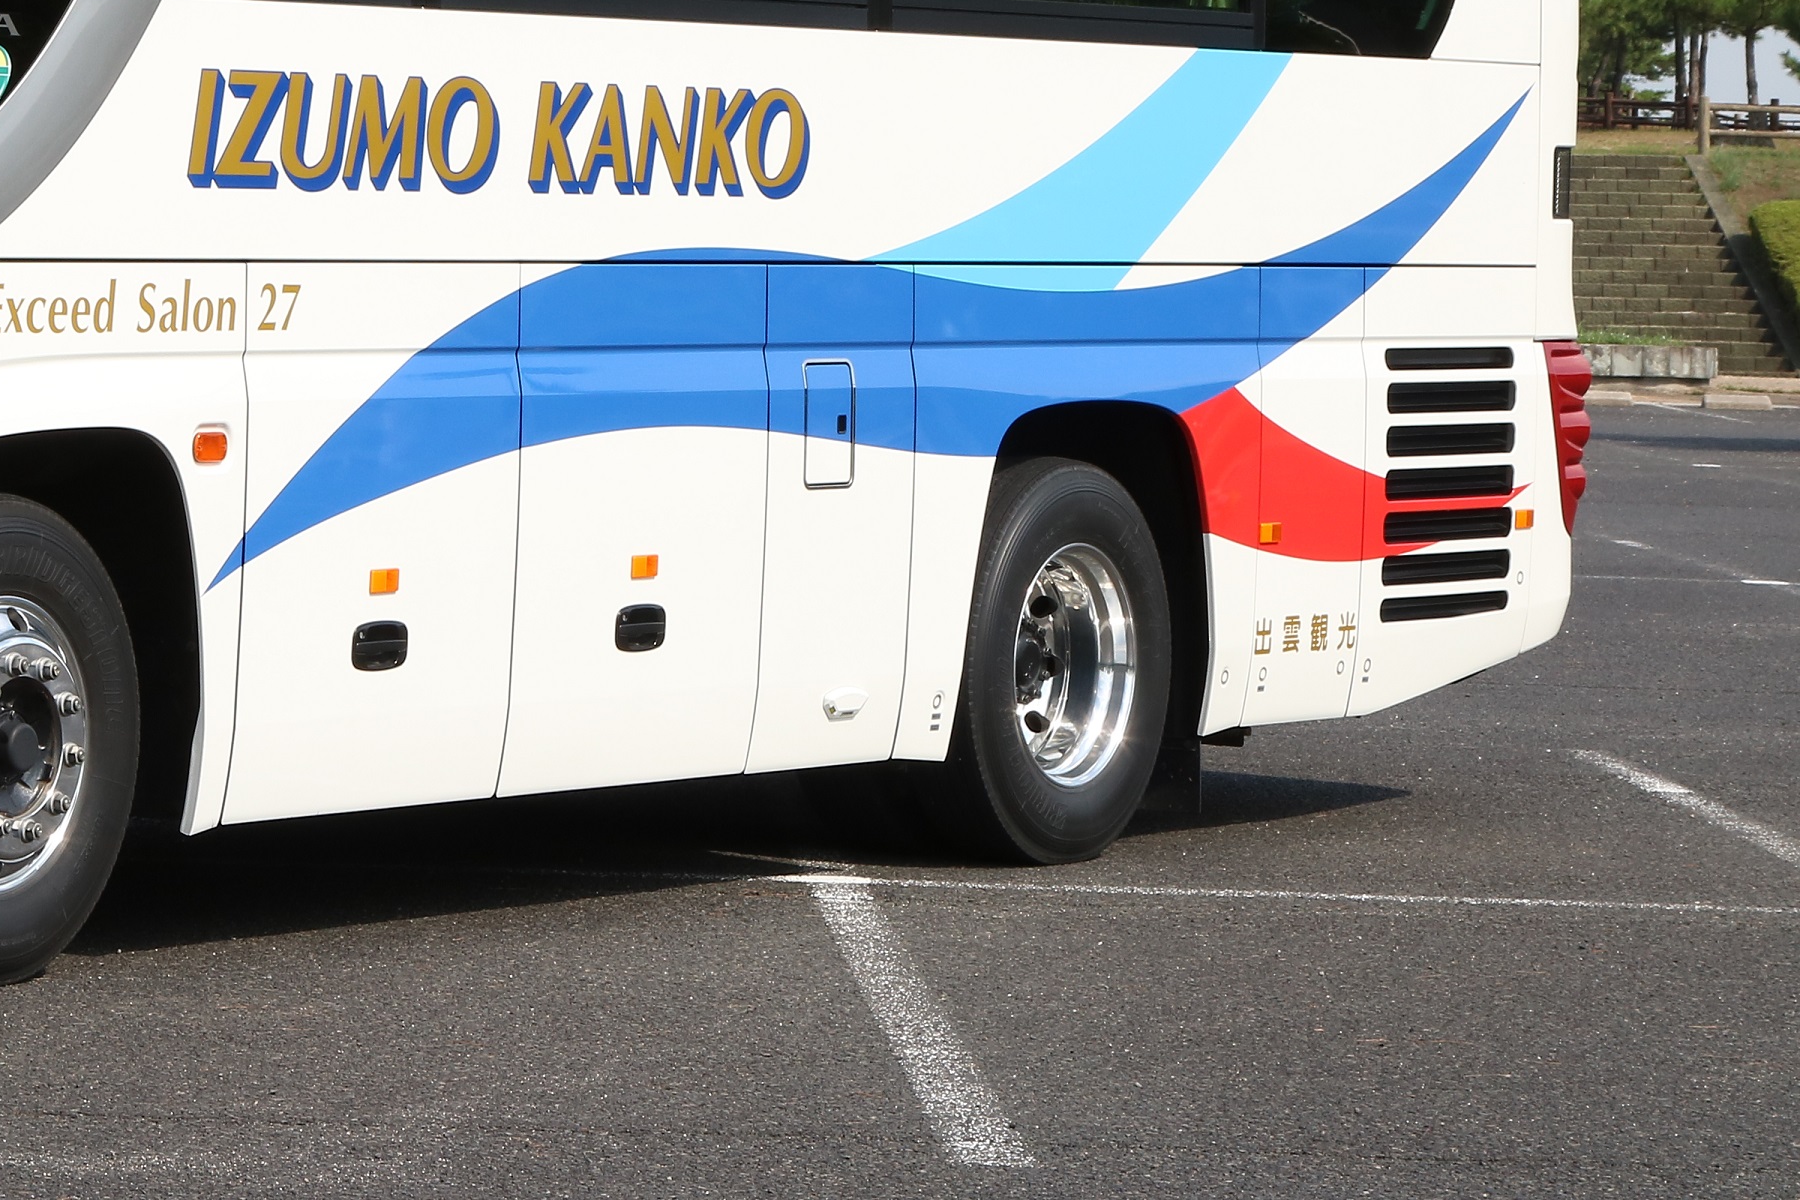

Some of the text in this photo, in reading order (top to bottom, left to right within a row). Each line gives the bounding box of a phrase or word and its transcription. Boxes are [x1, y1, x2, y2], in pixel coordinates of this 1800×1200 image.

[187, 68, 811, 200] IZUMO KANKO
[136, 278, 237, 334] Salon
[257, 283, 302, 332] 27
[1253, 611, 1357, 655] 出雲観光
